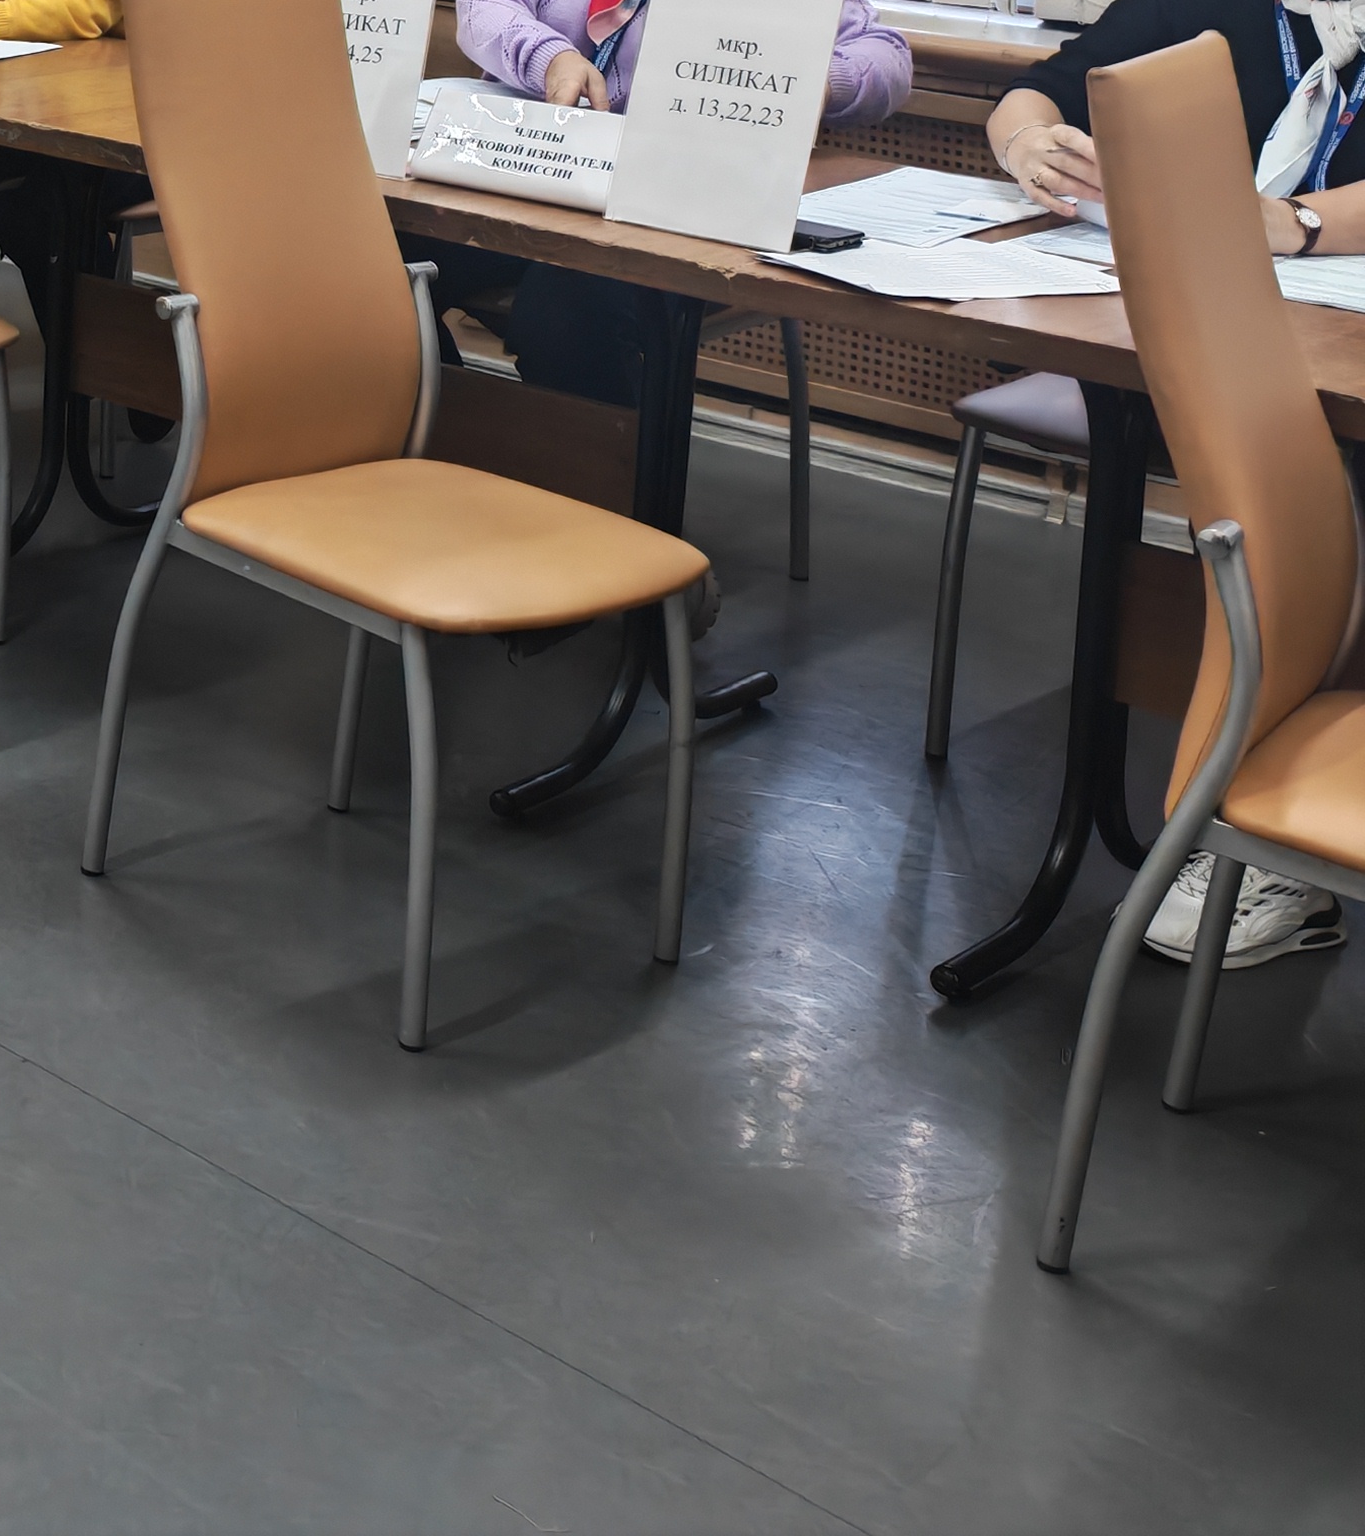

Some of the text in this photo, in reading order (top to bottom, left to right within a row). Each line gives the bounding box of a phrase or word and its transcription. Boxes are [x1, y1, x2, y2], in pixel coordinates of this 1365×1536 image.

[343, 13, 407, 35] ИКАТ
[716, 38, 764, 60] мкр.
[675, 60, 798, 94] СИЛИКАТ
[669, 97, 785, 127] д. 13,22,23
[515, 127, 566, 144] ЧЛЕНЫ
[491, 157, 574, 180] КОМИССИИ
